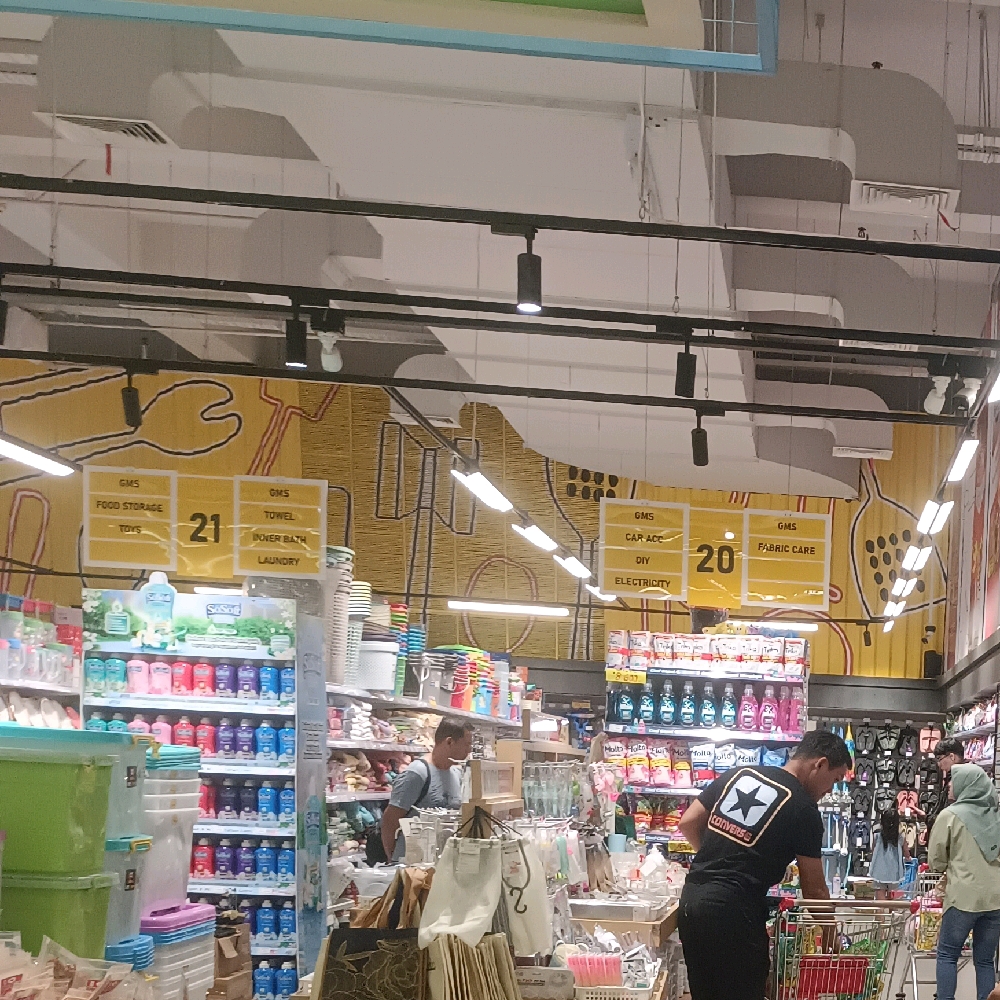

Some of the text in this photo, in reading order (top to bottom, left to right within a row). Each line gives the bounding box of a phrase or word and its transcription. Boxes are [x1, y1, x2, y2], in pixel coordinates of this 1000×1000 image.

[119, 478, 139, 488] GMS
[269, 488, 290, 498] GMS
[96, 501, 163, 513] FOOD STORAGE
[263, 510, 296, 521] TOWEL
[634, 511, 654, 520] GMS
[119, 524, 142, 534] TOYS
[189, 513, 220, 544] 21
[777, 522, 797, 531] GMS
[625, 533, 643, 542] CAR
[758, 542, 816, 555] FABRIC CARE
[257, 556, 300, 567] LAUNDRY
[635, 556, 651, 565] DIY
[696, 544, 735, 574] 20
[615, 577, 671, 588] ELECTRICITY
[207, 604, 241, 615] SoSoft
[711, 813, 752, 842] CONVERSE
